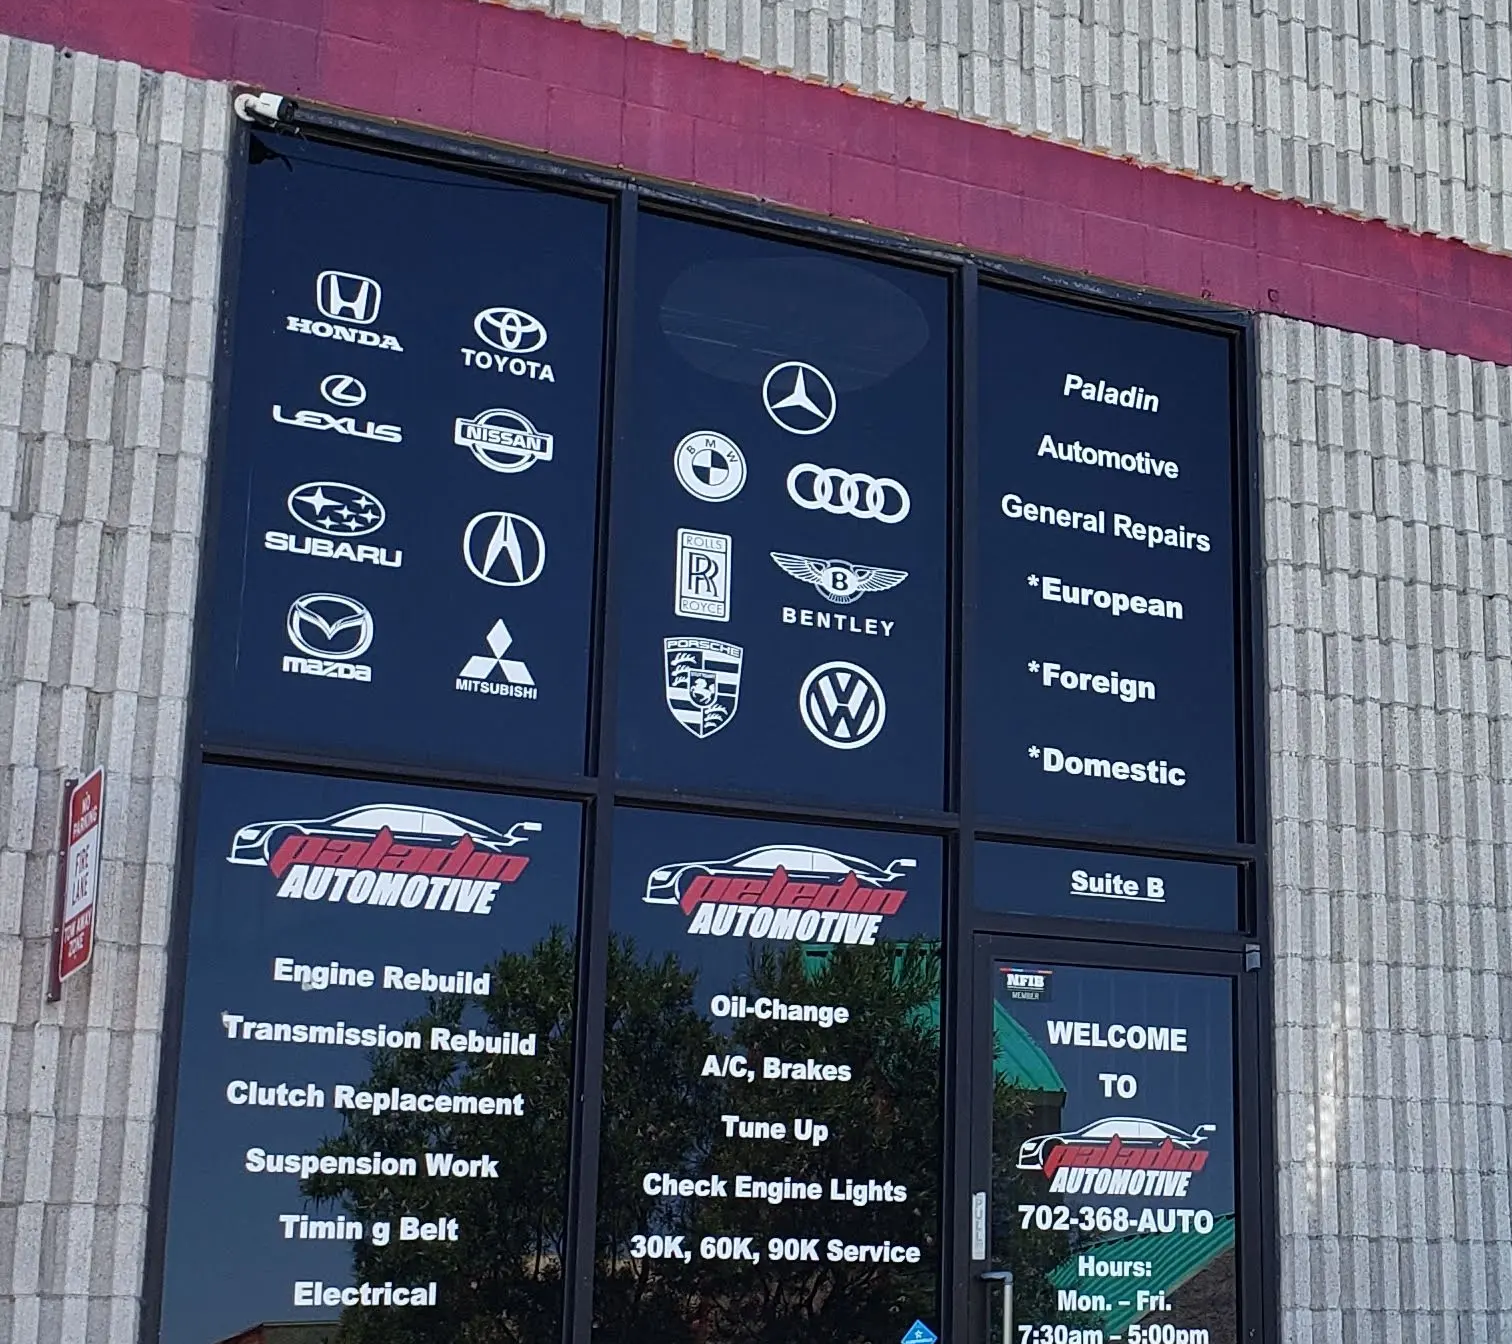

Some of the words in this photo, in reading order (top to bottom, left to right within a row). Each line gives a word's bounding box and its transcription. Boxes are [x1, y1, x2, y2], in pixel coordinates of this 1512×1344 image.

[286, 316, 403, 352] HONDA
[461, 347, 555, 383] TOYOTA
[1063, 374, 1160, 413] Paladin
[272, 404, 402, 443] LEXUS
[466, 425, 542, 452] NISSAN
[1037, 435, 1179, 479] Automotive
[1001, 494, 1105, 535] General
[1113, 514, 1211, 552] Repairs
[264, 531, 402, 567] SUBARU
[686, 535, 722, 550] ROLLS
[682, 599, 722, 616] ROYCE
[782, 606, 894, 637] BENTLEY
[667, 638, 740, 657] PORSCHE
[282, 656, 372, 682] mazda
[456, 678, 538, 700] MITSUBISHI
[270, 825, 530, 882] paladin
[276, 864, 502, 914] AUTOMOTIVE
[1071, 870, 1140, 897] Suite
[1146, 875, 1165, 898] B
[687, 902, 883, 946] AUTOMOTIVE
[273, 957, 374, 989] Engine
[383, 965, 491, 995] Rebuild
[1007, 974, 1044, 987] NFIB
[710, 993, 849, 1028] Oil-Change
[222, 1014, 421, 1050] Transmission
[430, 1027, 536, 1055] Rebuild
[1046, 1020, 1187, 1052] WELCOME
[701, 1054, 755, 1083] A/C,
[763, 1056, 852, 1082] Brakes
[226, 1081, 324, 1109] Clutch
[334, 1085, 524, 1116] Replacement
[1098, 1073, 1138, 1099] TO
[721, 1115, 786, 1140] Tune
[793, 1118, 829, 1146] Up
[245, 1148, 416, 1178] Suspension
[425, 1153, 499, 1179] Work
[1043, 1133, 1209, 1179] paladin
[643, 1172, 727, 1198] Check
[735, 1176, 822, 1204] Engine
[830, 1178, 907, 1207] Lights
[1049, 1167, 1192, 1197] AUTOMOTIVE
[400, 1216, 458, 1241] Belt
[1018, 1204, 1214, 1234] 702-368-AUTO
[630, 1235, 692, 1263] 30K,
[700, 1236, 760, 1265] 60K,
[768, 1237, 819, 1261] 90K
[826, 1239, 920, 1263] Service
[1077, 1255, 1152, 1278] Hours:
[293, 1282, 437, 1306] Electrical
[1057, 1289, 1112, 1312] Mon.
[1136, 1289, 1172, 1312] Fri.
